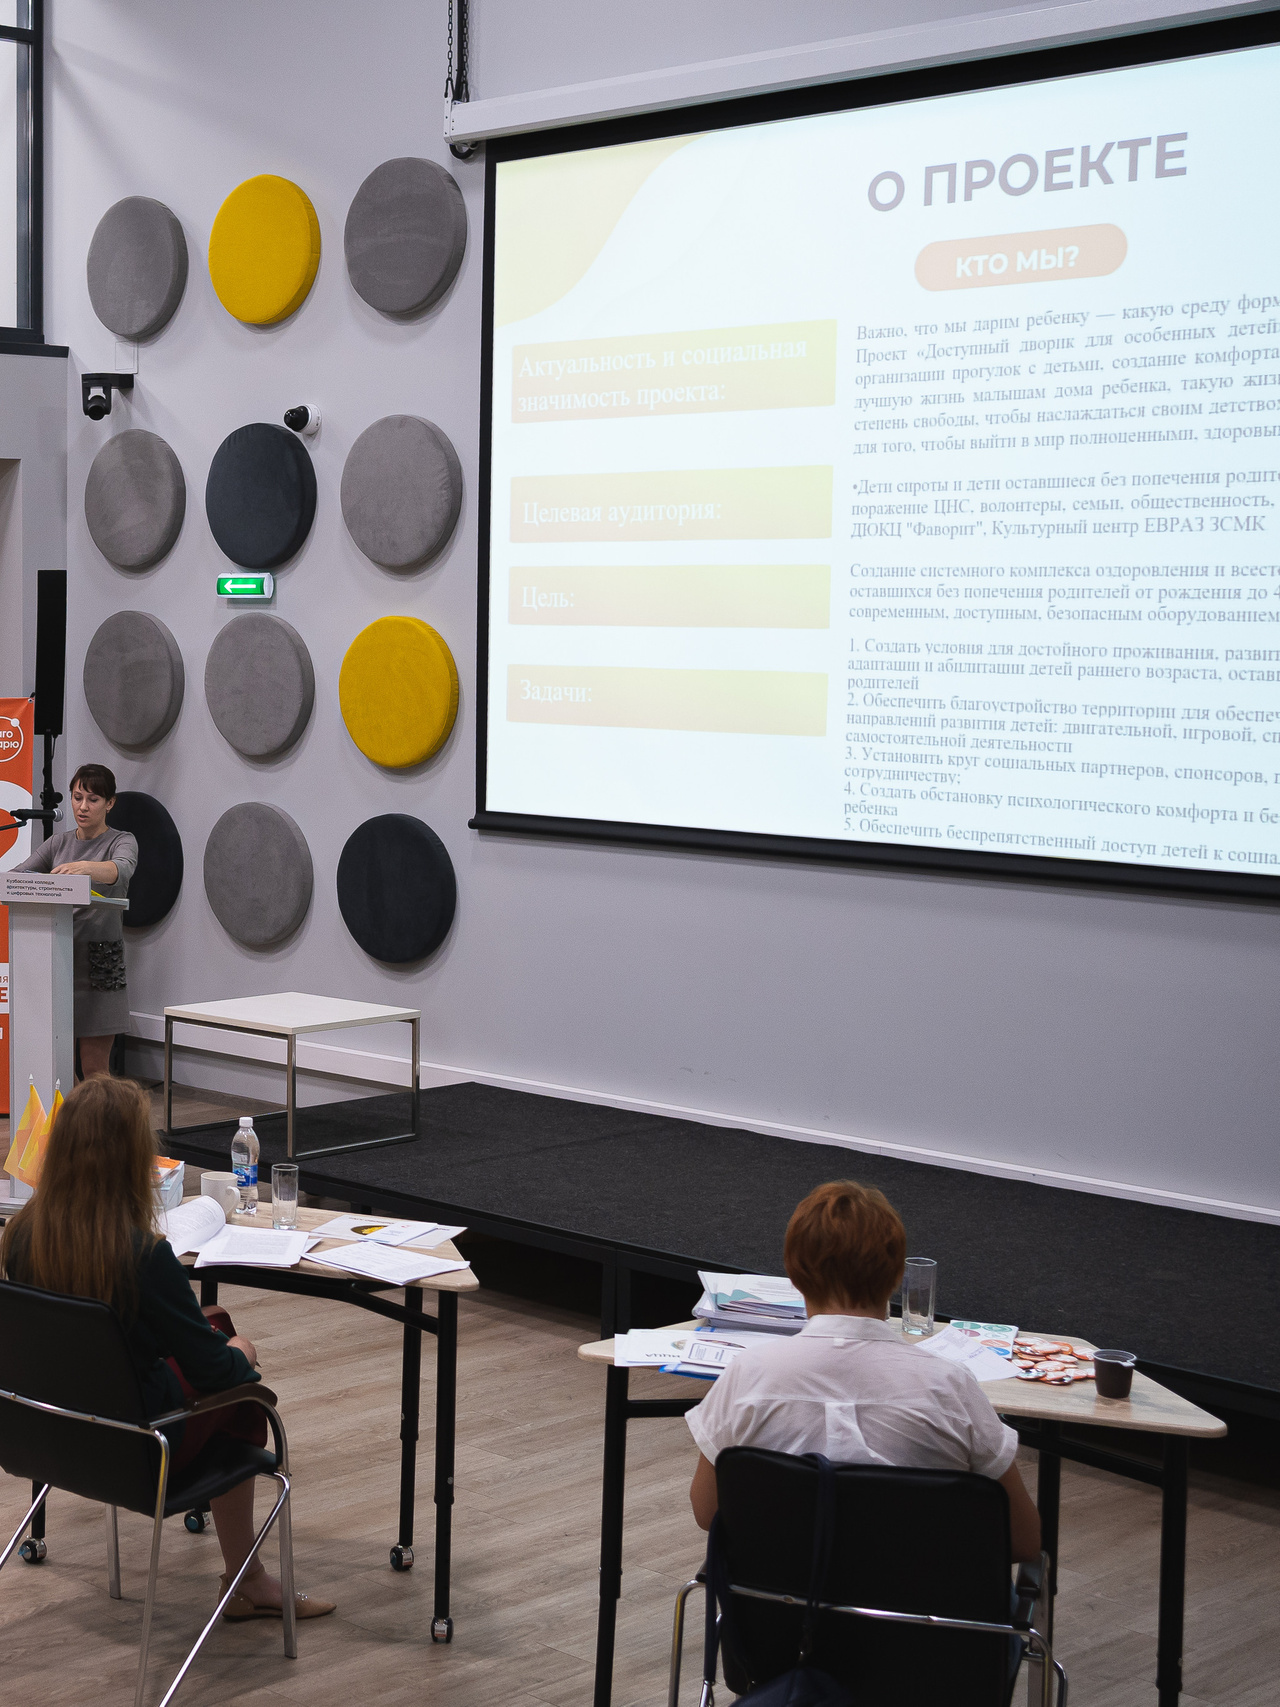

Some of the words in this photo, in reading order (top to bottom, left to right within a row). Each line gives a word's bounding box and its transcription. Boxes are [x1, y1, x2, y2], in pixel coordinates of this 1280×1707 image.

[867, 170, 906, 212] О
[923, 131, 1188, 207] ПРОЕКТЕ
[955, 252, 1009, 278] КТО
[1015, 245, 1080, 273] МЫ?
[914, 324, 939, 336] что
[944, 321, 967, 334] мы
[972, 316, 1020, 335] дарим
[1026, 309, 1091, 332] ребенку
[1121, 304, 1175, 322] какую
[1180, 299, 1230, 320] среду
[856, 348, 908, 367] Проект
[916, 338, 1010, 361] «Доступный
[1018, 337, 1075, 355] дворик
[1084, 334, 1114, 348] для
[1123, 325, 1217, 345] особенных
[518, 351, 656, 380] Актуальность
[662, 352, 676, 367] и
[681, 340, 808, 366] социальная
[854, 369, 946, 390] организации
[952, 364, 1022, 384] прогулок
[1111, 353, 1187, 370] создание
[517, 389, 631, 412] значимость
[637, 383, 726, 410] проекта:
[853, 395, 913, 413] лучшую
[919, 392, 966, 406] жизнь
[972, 387, 1046, 403] малышам
[1053, 385, 1093, 399] дома
[1180, 376, 1234, 394] такую
[1242, 373, 1280, 387] жиз
[853, 418, 909, 431] степень
[984, 408, 1032, 425] чтобы
[1036, 405, 1146, 423] наслаждаться
[1151, 402, 1204, 417] своим
[1208, 398, 1280, 415] детство
[852, 442, 878, 455] для
[920, 435, 966, 452] чтобы
[969, 433, 1017, 450] выйти
[1033, 435, 1065, 451] мир
[1203, 424, 1280, 444] здоровы
[896, 480, 949, 497] сироты
[965, 479, 1001, 492] дети
[1004, 476, 1096, 490] оставшиеся
[1100, 471, 1127, 487] без
[1131, 472, 1221, 487] попечения
[1225, 470, 1280, 489] родит
[523, 501, 602, 526] Целевая
[608, 502, 722, 527] аудитория:
[851, 503, 929, 520] поражение
[850, 521, 902, 539] ДЮКЦ
[991, 519, 1088, 540] Культурный
[1092, 522, 1140, 538] центр
[1143, 516, 1205, 534] ЕВРАЗ
[1209, 515, 1266, 532] ЗСМК
[850, 563, 917, 578] Создание
[919, 566, 1006, 578] системного
[1009, 565, 1092, 578] комплекса
[1095, 565, 1210, 582] оздоровления
[1230, 564, 1280, 578] всест
[521, 585, 575, 612] Цель:
[849, 587, 933, 599] оставшихся
[936, 583, 960, 599] без
[963, 587, 1044, 599] попечения
[1047, 583, 1131, 603] родителей
[1134, 587, 1155, 600] от
[1158, 587, 1243, 604] рождения
[1246, 588, 1269, 601] до
[1046, 604, 1143, 622] безопасным
[850, 637, 860, 653] 1.
[864, 638, 921, 654] Создать
[924, 642, 984, 655] условия
[986, 644, 1014, 656] для
[1017, 641, 1109, 658] достойного
[847, 659, 921, 672] адаптации
[937, 657, 1026, 675] абилитации
[1028, 661, 1073, 677] детей
[1077, 665, 1142, 680] раннего
[1227, 669, 1280, 683] остав
[847, 675, 920, 691] родителей
[520, 678, 593, 704] Задачи:
[846, 691, 859, 707] 2.
[862, 692, 947, 710] Обеспечить
[949, 695, 1078, 715] благоустройство
[1081, 704, 1176, 720] территории
[1180, 707, 1211, 721] для
[846, 713, 937, 728] направлений
[940, 717, 1006, 732] развития
[845, 732, 967, 749] самостоятельной
[969, 737, 1073, 754] деятельности
[844, 745, 857, 760] 3.
[862, 746, 944, 765] Установить
[947, 754, 981, 770] круг
[983, 757, 1077, 773] социальных
[843, 780, 856, 796] 4.
[859, 782, 917, 800] Создать
[920, 786, 1004, 809] обстановку
[1007, 795, 1151, 816] психологического
[1155, 803, 1239, 824] комфорта
[843, 799, 899, 818] ребенка
[843, 817, 856, 832] 5.
[859, 818, 943, 839] Обеспечить
[946, 824, 1097, 851] беспрепятственный
[1100, 840, 1157, 858] доступ
[1160, 844, 1209, 860] детей
[1227, 850, 1280, 866] социа
